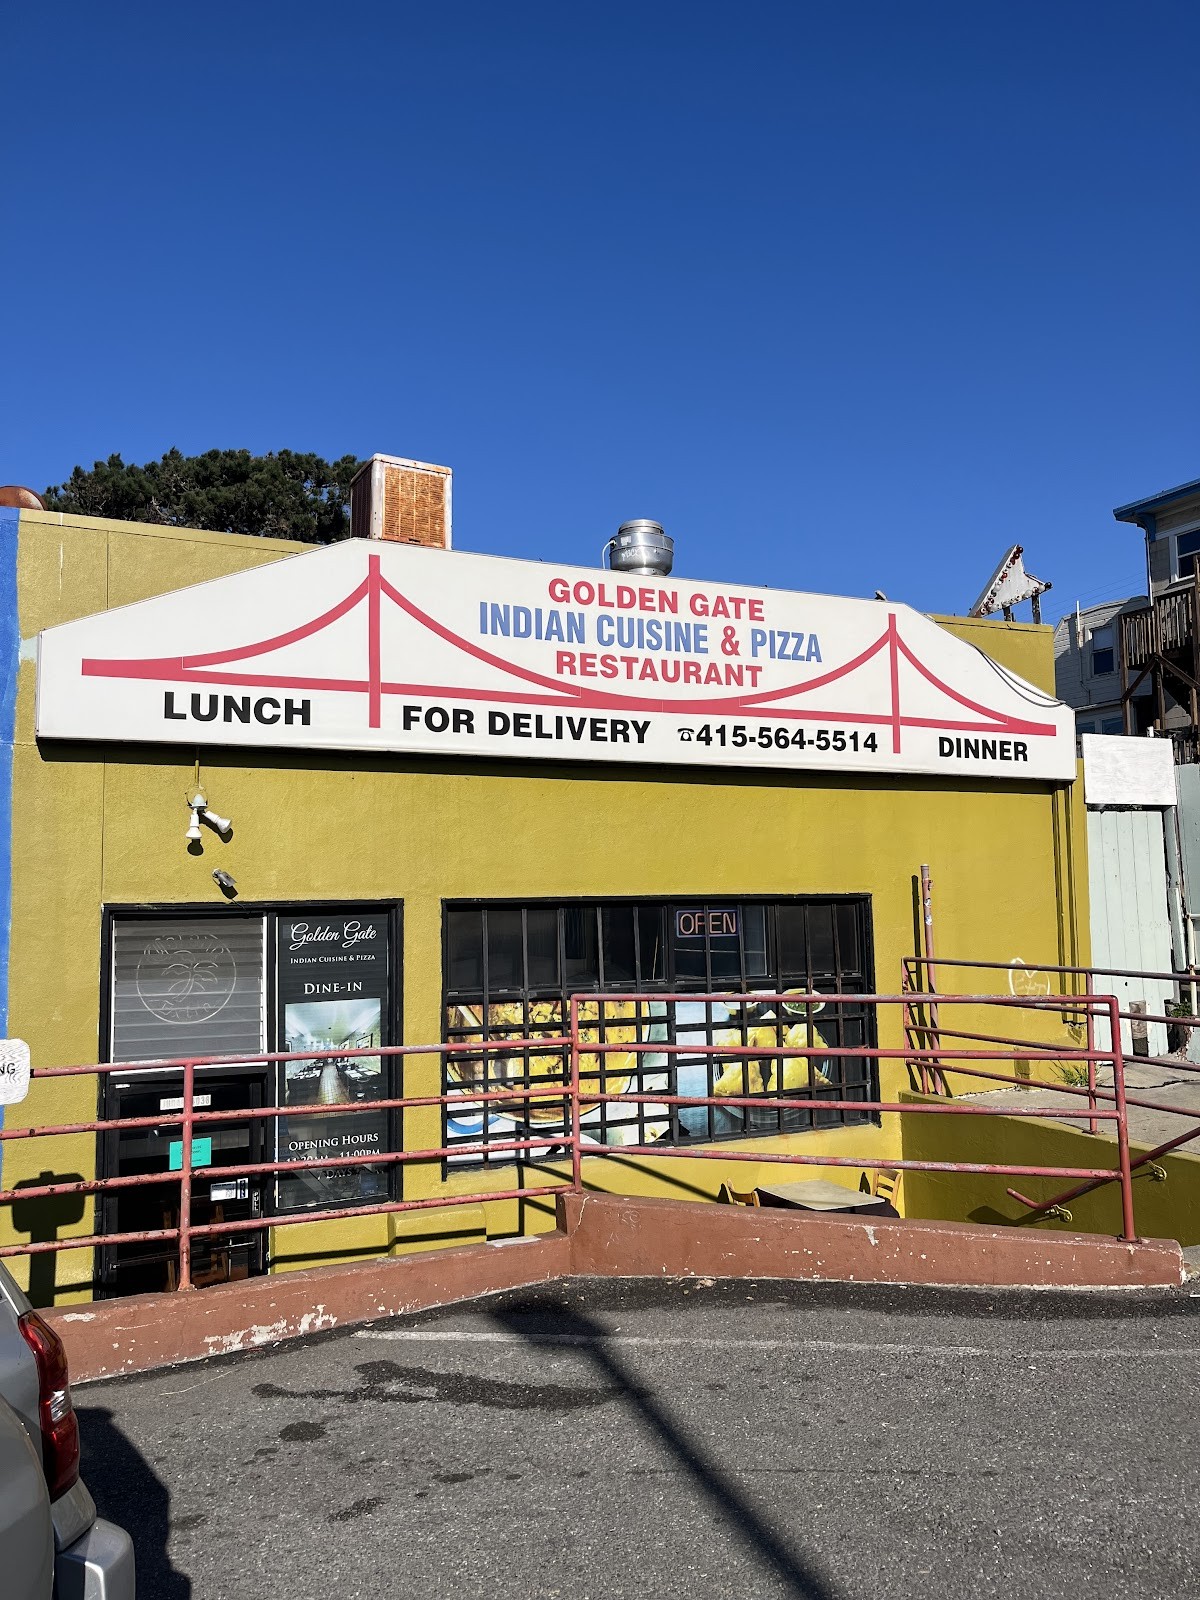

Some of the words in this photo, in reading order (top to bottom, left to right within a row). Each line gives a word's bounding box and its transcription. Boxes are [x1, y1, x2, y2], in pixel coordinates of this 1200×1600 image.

[549, 578, 678, 613] GOLDEN
[690, 593, 764, 621] GATE
[480, 602, 585, 644] INDIAN
[597, 614, 708, 653] CUISINE
[721, 625, 740, 656] &
[752, 629, 821, 662] PIZZA
[556, 651, 762, 687] RESTAURANT
[164, 691, 311, 725] LUNCH
[403, 705, 474, 733] FOR
[488, 710, 651, 744] DELIVERY
[697, 725, 878, 753] 415-564-5514
[939, 737, 1028, 761] DINNER
[289, 922, 340, 950] Golden
[342, 920, 377, 948] Gate
[680, 913, 736, 934] OPEN
[318, 955, 348, 963] CUISINE
[304, 981, 363, 995] DINE-IN
[288, 1138, 339, 1151] OPENING
[342, 1133, 379, 1145] HOURS
